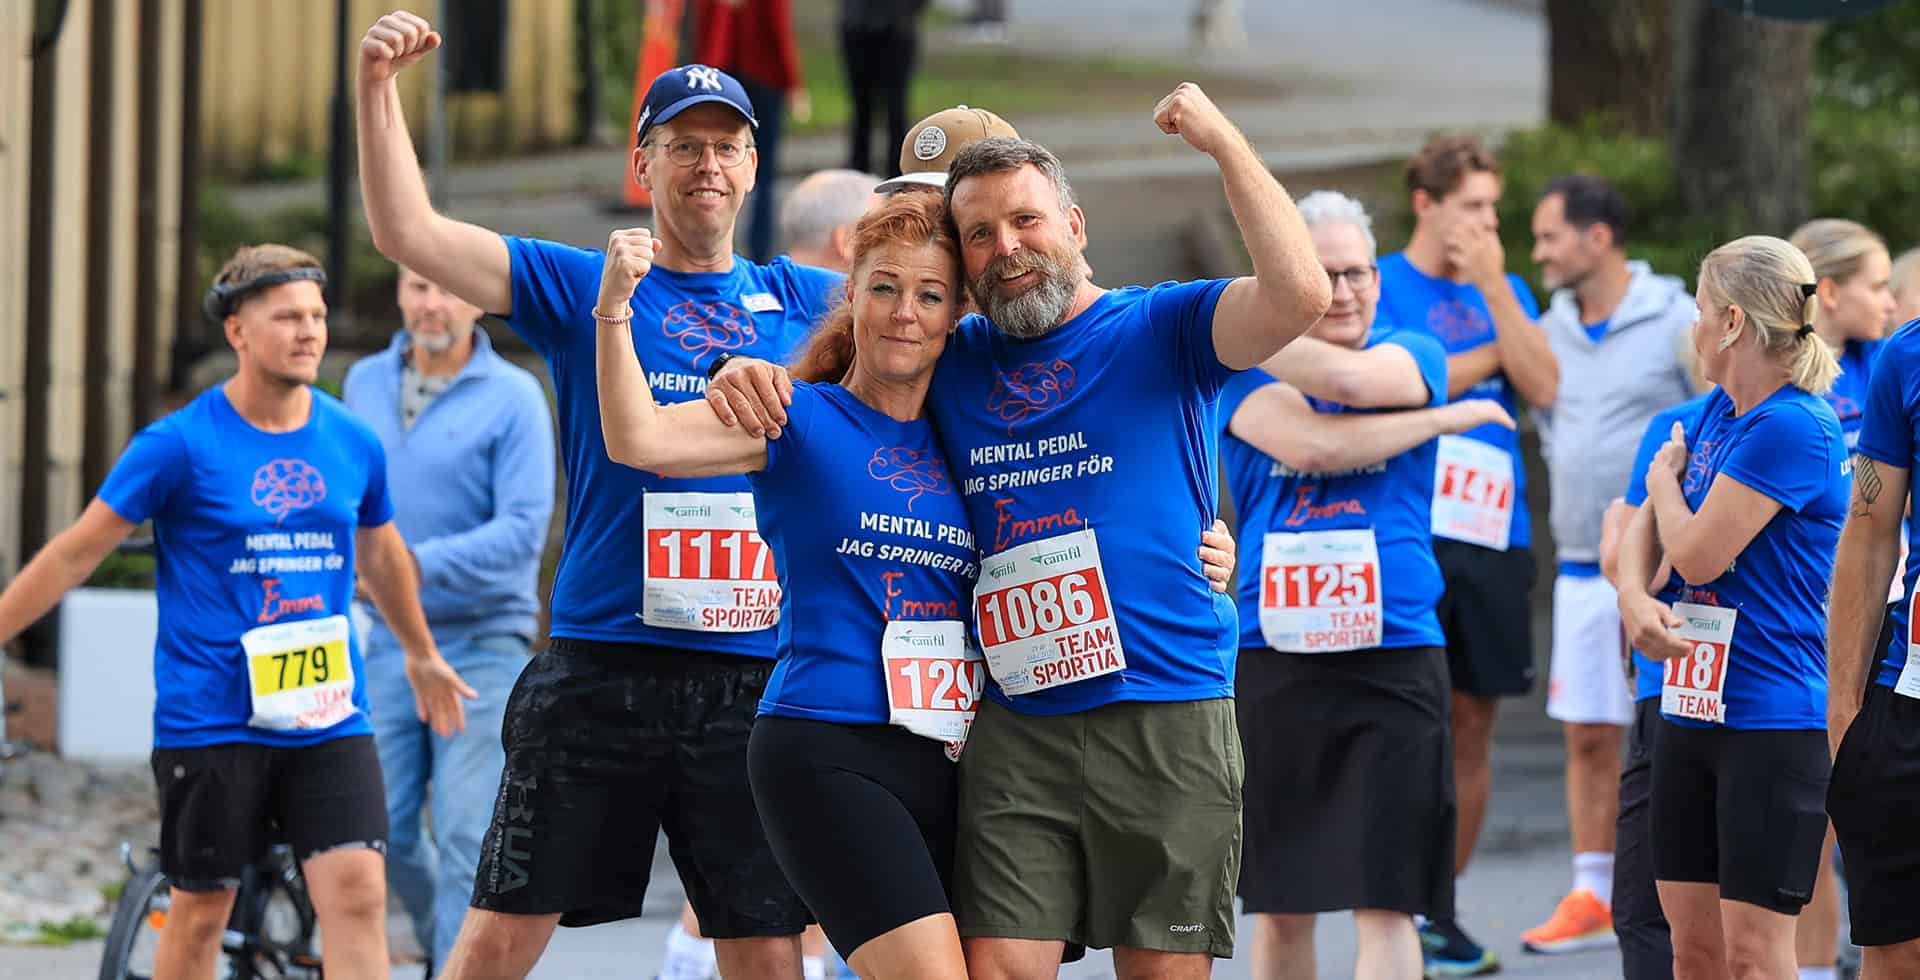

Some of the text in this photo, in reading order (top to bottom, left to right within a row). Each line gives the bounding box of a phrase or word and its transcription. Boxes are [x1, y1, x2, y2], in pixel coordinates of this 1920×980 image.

[686, 67, 722, 91] NY
[649, 371, 711, 394] MENTA
[970, 431, 1087, 466] MENTAL PEDAL
[964, 454, 1113, 496] JAG SPRINGER FÖR
[994, 498, 1082, 551] Emma
[1284, 485, 1366, 526] Emma
[860, 512, 976, 551] MENTAL PEDAL
[660, 531, 769, 580] 1117
[836, 538, 874, 557] JAG
[877, 544, 962, 573] SPRINGER
[733, 587, 780, 607] TEAM
[881, 572, 958, 621] Emma
[1270, 564, 1368, 608] 1125
[702, 607, 778, 628] SPORTIA
[986, 573, 1095, 643] 1086
[1055, 626, 1115, 657] TEAM
[272, 646, 329, 690] 779
[1033, 647, 1120, 685] SPORTIA
[1678, 693, 1718, 717] TEAM
[1169, 924, 1199, 933] CRAFT
